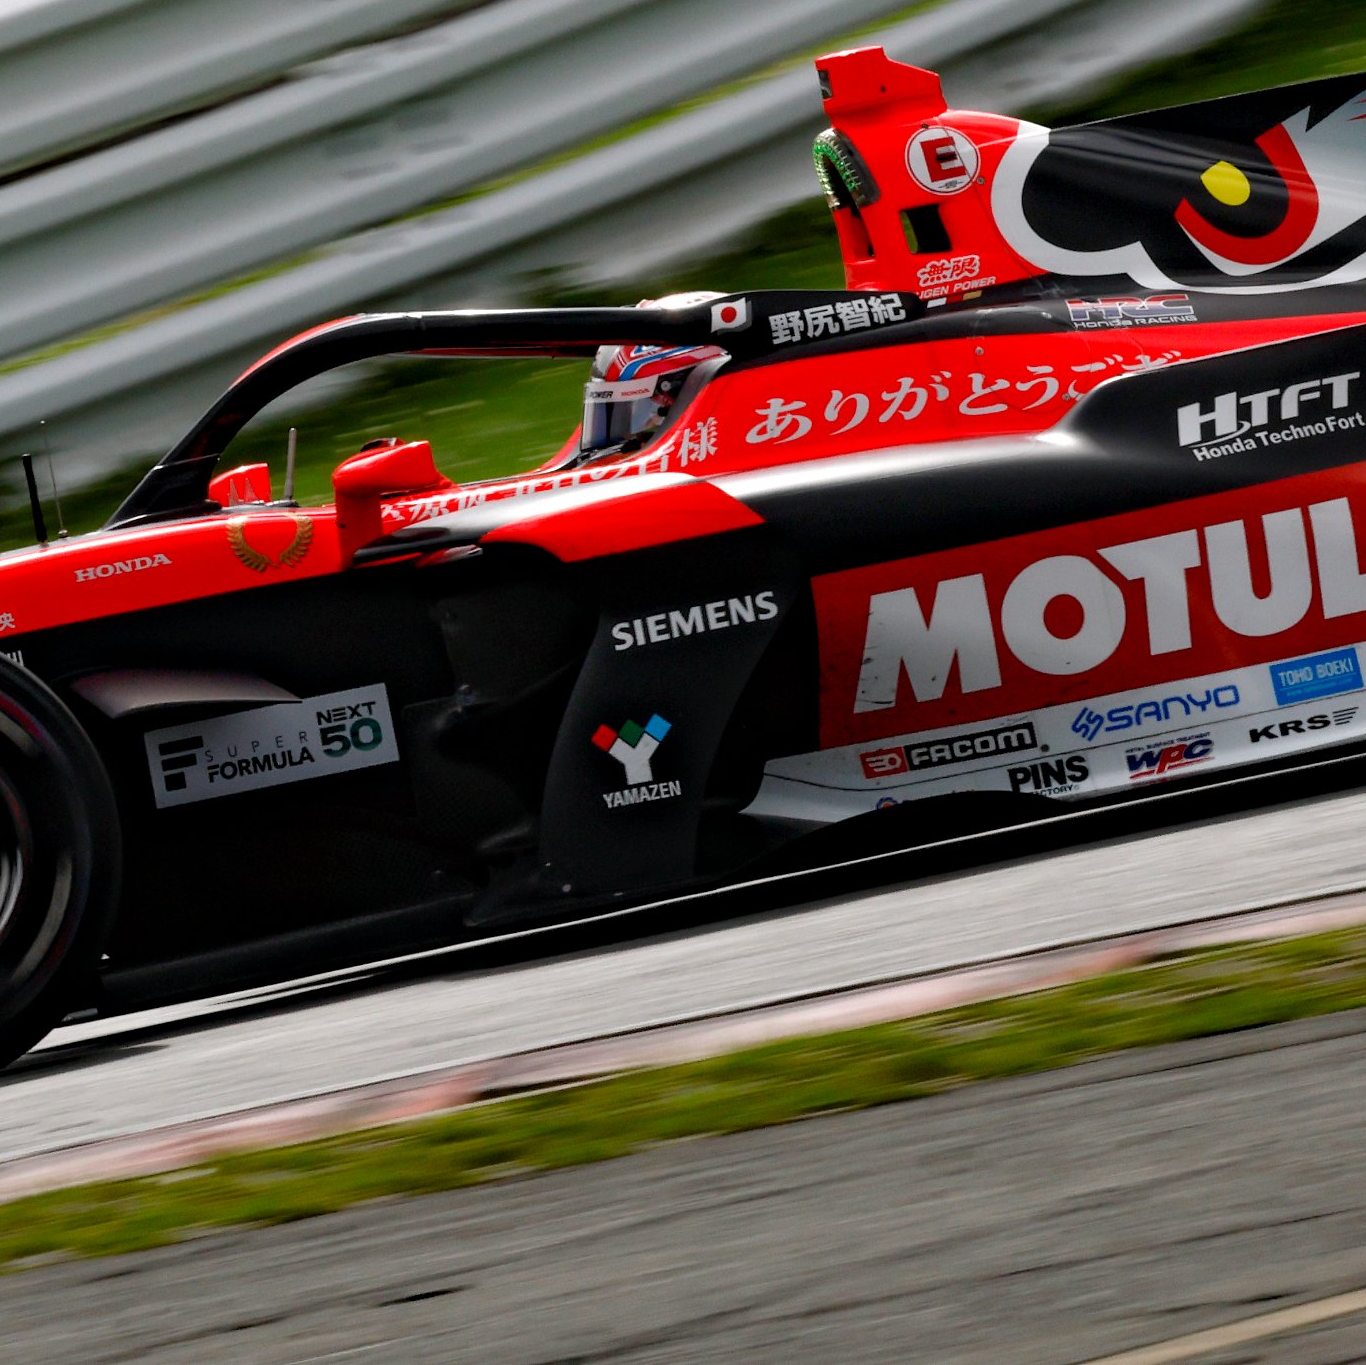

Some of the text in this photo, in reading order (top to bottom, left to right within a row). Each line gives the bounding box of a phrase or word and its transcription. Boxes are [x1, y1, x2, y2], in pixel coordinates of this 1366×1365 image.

[919, 136, 967, 183] E
[915, 276, 997, 300] UGEN POWER
[768, 293, 906, 345] 野尻智紀
[1066, 294, 1195, 322] HRC
[1073, 314, 1198, 329] Honda RACING
[1177, 371, 1360, 447] HTFT
[1192, 439, 1257, 462] Honda
[74, 553, 172, 582] HONDA
[611, 591, 779, 651] SIEMENS
[1278, 666, 1313, 687] TOHO
[1317, 658, 1354, 679] BOEKI
[316, 701, 376, 725] NEXT
[1105, 685, 1240, 732] SANYO
[319, 718, 383, 758] 50
[1249, 714, 1331, 743] KRS
[205, 731, 308, 762] SUPER
[910, 728, 1032, 766] FACOM
[207, 746, 315, 783] FORMULA
[1007, 756, 1089, 793] PINS
[602, 780, 682, 809] YAMAZEN
